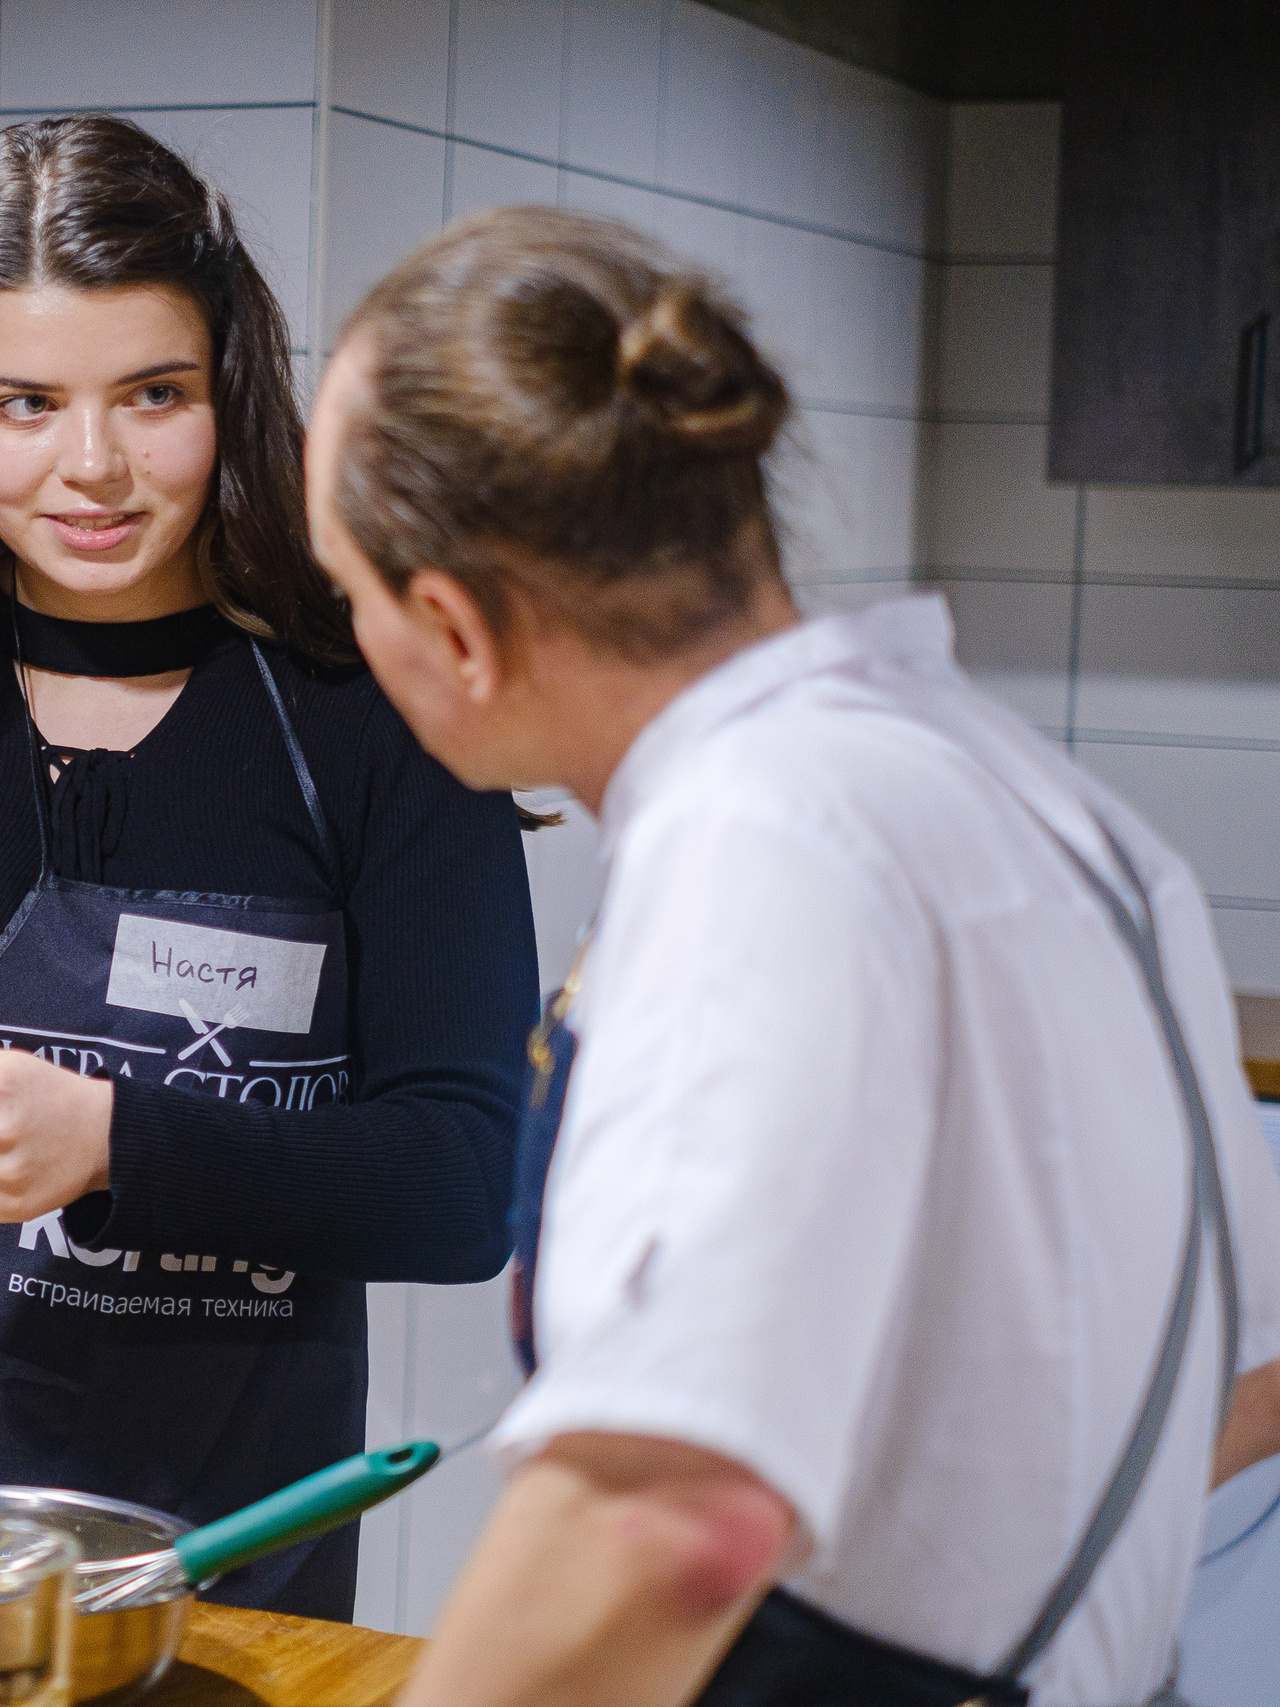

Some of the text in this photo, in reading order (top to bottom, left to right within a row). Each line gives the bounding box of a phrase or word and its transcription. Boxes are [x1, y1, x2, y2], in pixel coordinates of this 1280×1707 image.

[152, 940, 257, 991] Настя
[8, 1273, 293, 1317] встраиваемая техника
